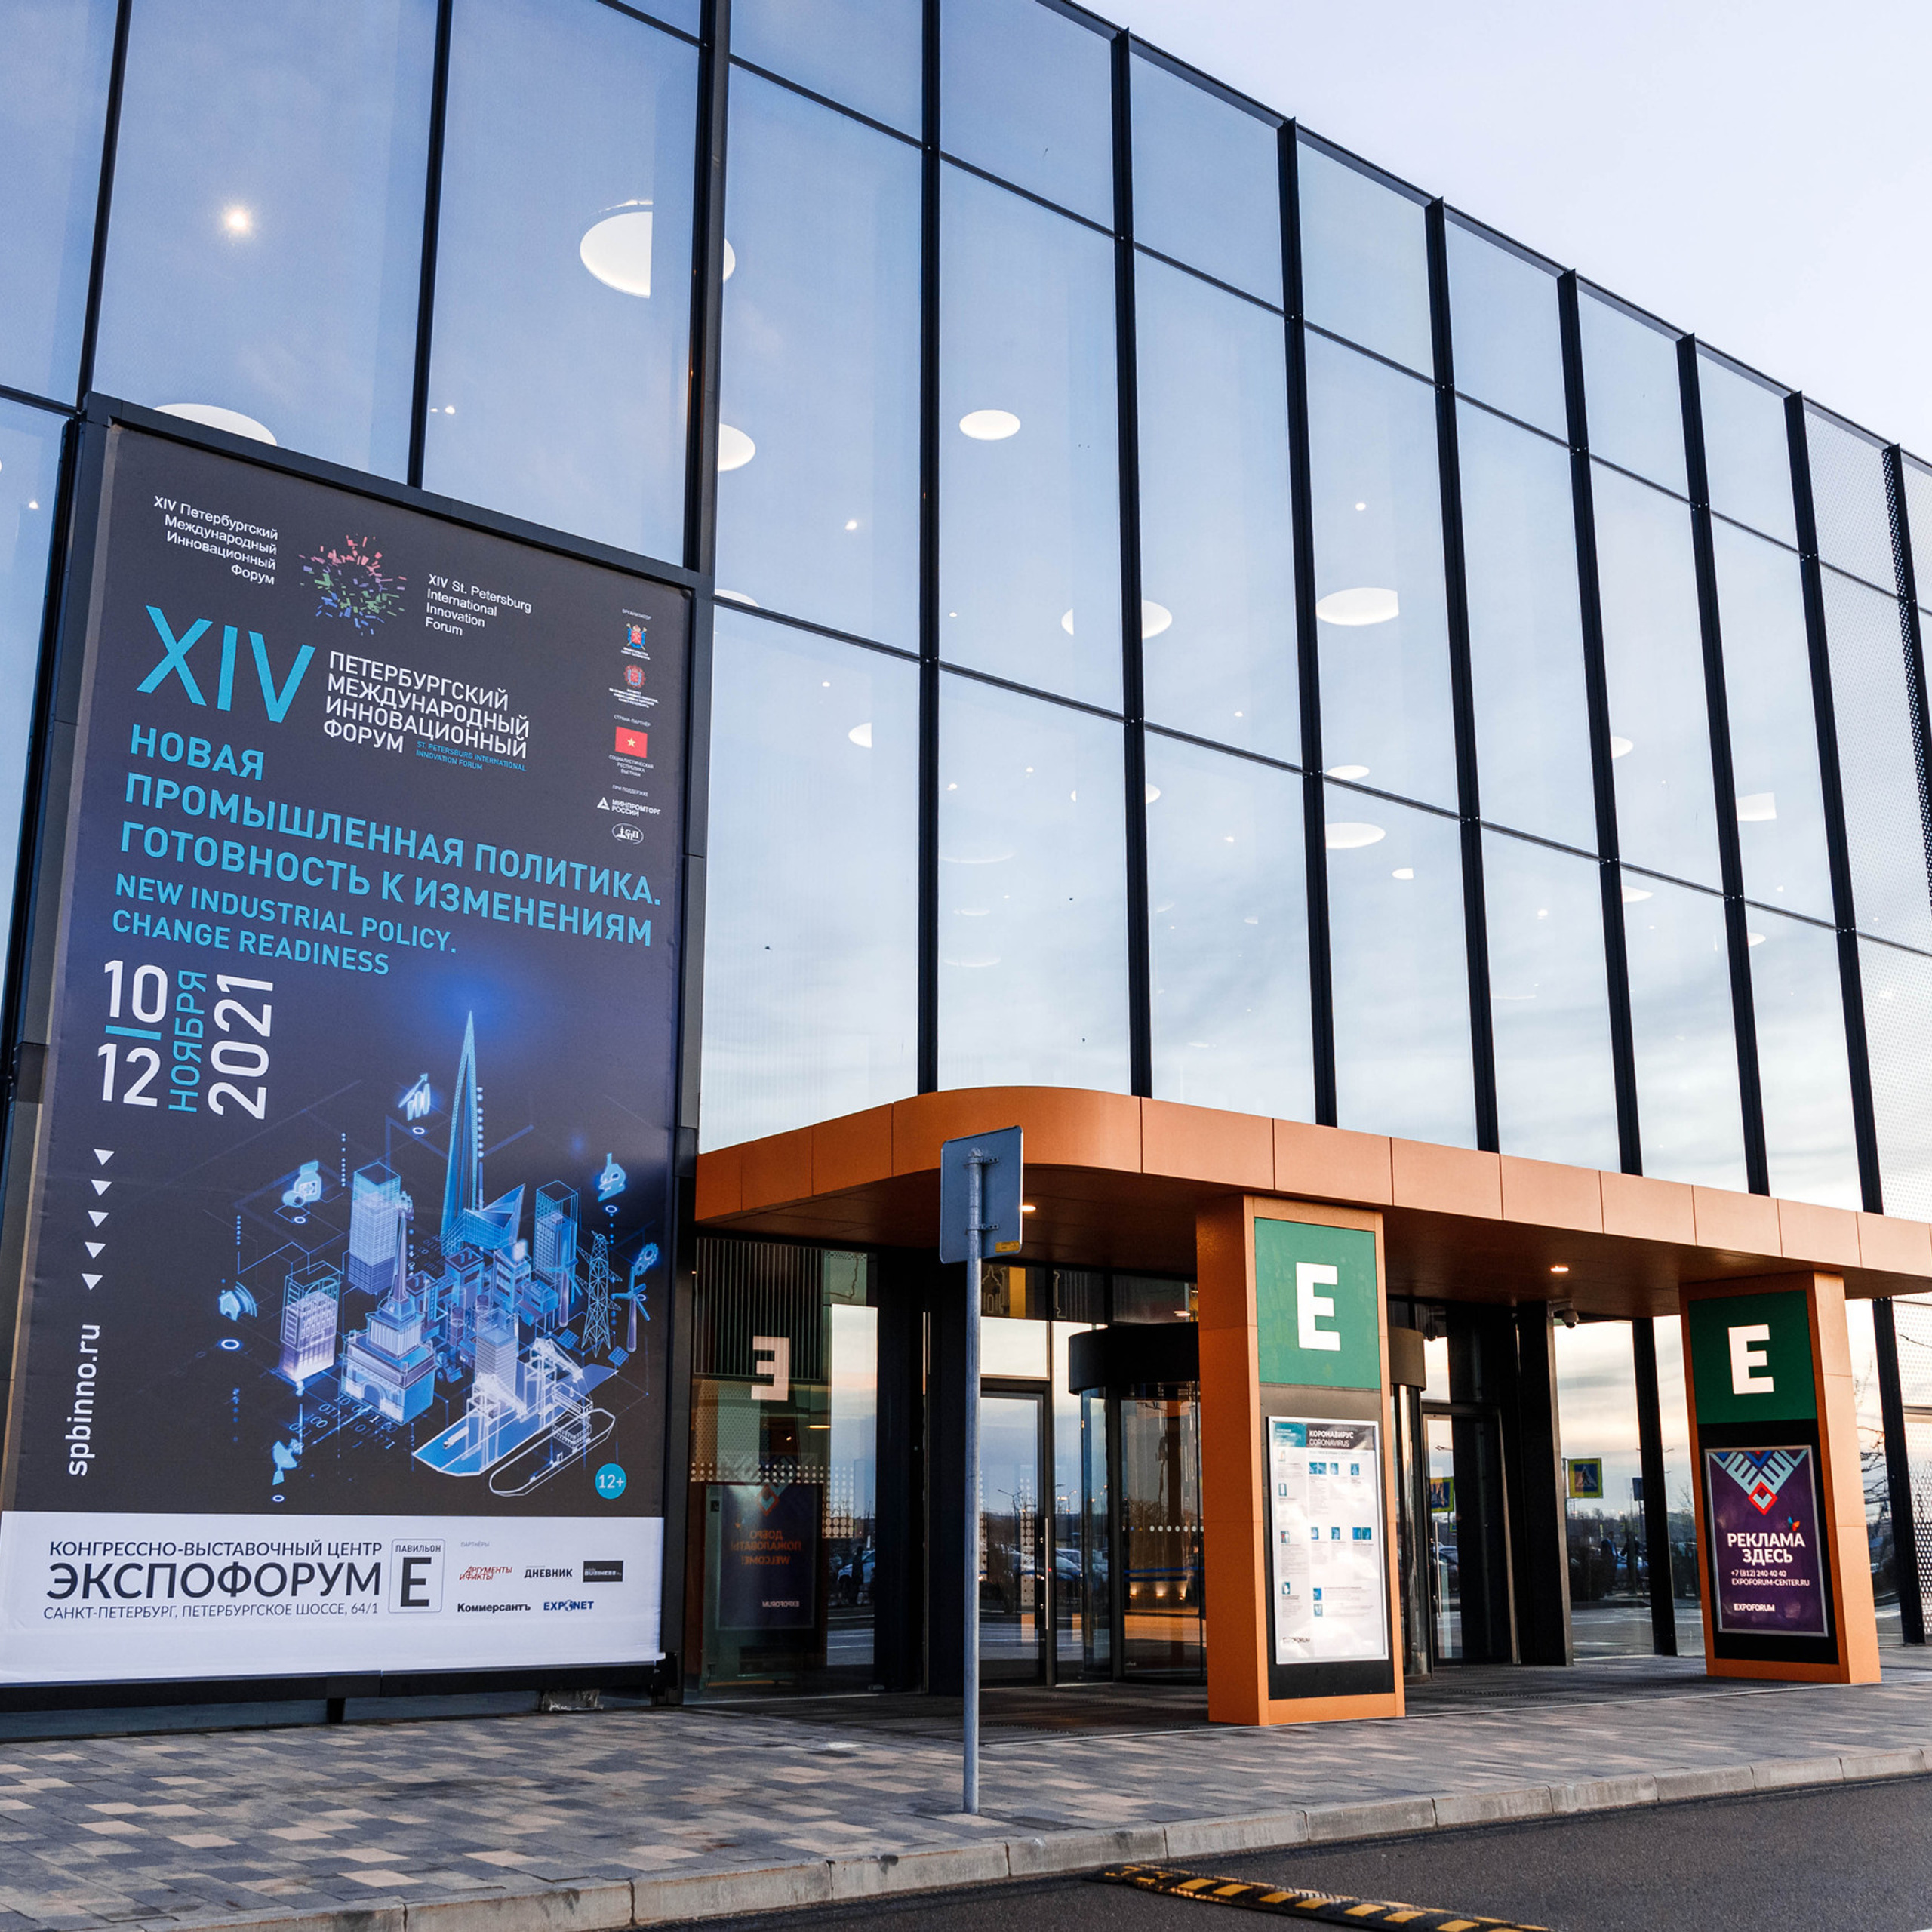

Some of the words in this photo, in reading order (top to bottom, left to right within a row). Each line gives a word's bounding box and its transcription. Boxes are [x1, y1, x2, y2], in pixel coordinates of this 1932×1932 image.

[153, 495, 177, 512] XIV
[180, 503, 278, 540] Петербургский
[165, 514, 278, 555] Международный
[166, 531, 276, 571] Инновационный
[231, 564, 275, 585] Форум
[426, 587, 497, 617] International
[428, 574, 448, 589] XIV
[451, 580, 467, 595] St.
[470, 585, 532, 614] Petersburg
[425, 616, 463, 636] Forum
[426, 601, 485, 628] Innovation
[136, 605, 316, 724] XIV
[329, 651, 509, 711] ПЕТЕРБУРГСКИЙ
[328, 673, 530, 738] МЕЖДУНАРОДНЫЙ
[323, 718, 405, 753] ФОРУМ
[325, 695, 528, 759] ИННОВАЦИОННЫЙ
[130, 724, 264, 781] НОВАЯ
[416, 749, 457, 765] INNOVATION
[459, 759, 483, 771] FORUM
[428, 743, 473, 760] PETERSBURG
[474, 753, 528, 772] INTERNATIONAL
[611, 805, 640, 817] РОССИИ
[612, 799, 661, 815] МИНПРОМТОРГ
[125, 772, 464, 868] ПРОМЫШЛЕННАЯ
[475, 843, 661, 906] ПОЛИТИКА.
[121, 820, 371, 896] ГОТОВНОСТЬ
[381, 870, 405, 903] К
[414, 877, 652, 947] ИЗМЕНЕНИЯМ
[115, 873, 183, 906] NEW
[191, 887, 354, 936] INDUSTRIAL
[361, 916, 457, 953] POLICY.
[112, 909, 231, 950] CHANGE
[238, 930, 389, 975] READINESS
[104, 959, 168, 1023] 10
[168, 969, 208, 1113] НОЯБРЯ
[207, 974, 274, 1121] 2021
[97, 1042, 161, 1107] 12
[1296, 1262, 1341, 1352] E
[1727, 1324, 1774, 1395] E
[65, 1324, 100, 1476] spbinno.ru
[1309, 1430, 1354, 1439] КОРОНАВИРУС
[1309, 1438, 1349, 1447] CORONAVIRUS
[598, 1474, 624, 1489] 12+
[49, 1540, 322, 1557] КОНГРЕССНО-ВЫСТАВОЧНЫЙ
[328, 1542, 382, 1558] ЦЕНТР
[395, 1545, 441, 1553] ПАВИЛЬОН
[1727, 1533, 1806, 1548] РЕКЛАМА
[1742, 1548, 1793, 1566] ЗДЕСЬ
[46, 1561, 381, 1599] ЭКСПОФОРУМ
[465, 1566, 512, 1574] АРГУМЕНТЫ
[524, 1568, 573, 1579] ДНЕВНИК
[1731, 1578, 1810, 1587] EXPOFORUM-CENTER.RU
[43, 1605, 178, 1619] САНКТ-ПЕТЕРБУРГ,
[182, 1604, 292, 1618] ПЕТЕРБУРГСКОЕ
[296, 1603, 348, 1616] ШОССЕ,
[351, 1602, 378, 1614] 64/1
[457, 1603, 531, 1613] Коммерсантъ
